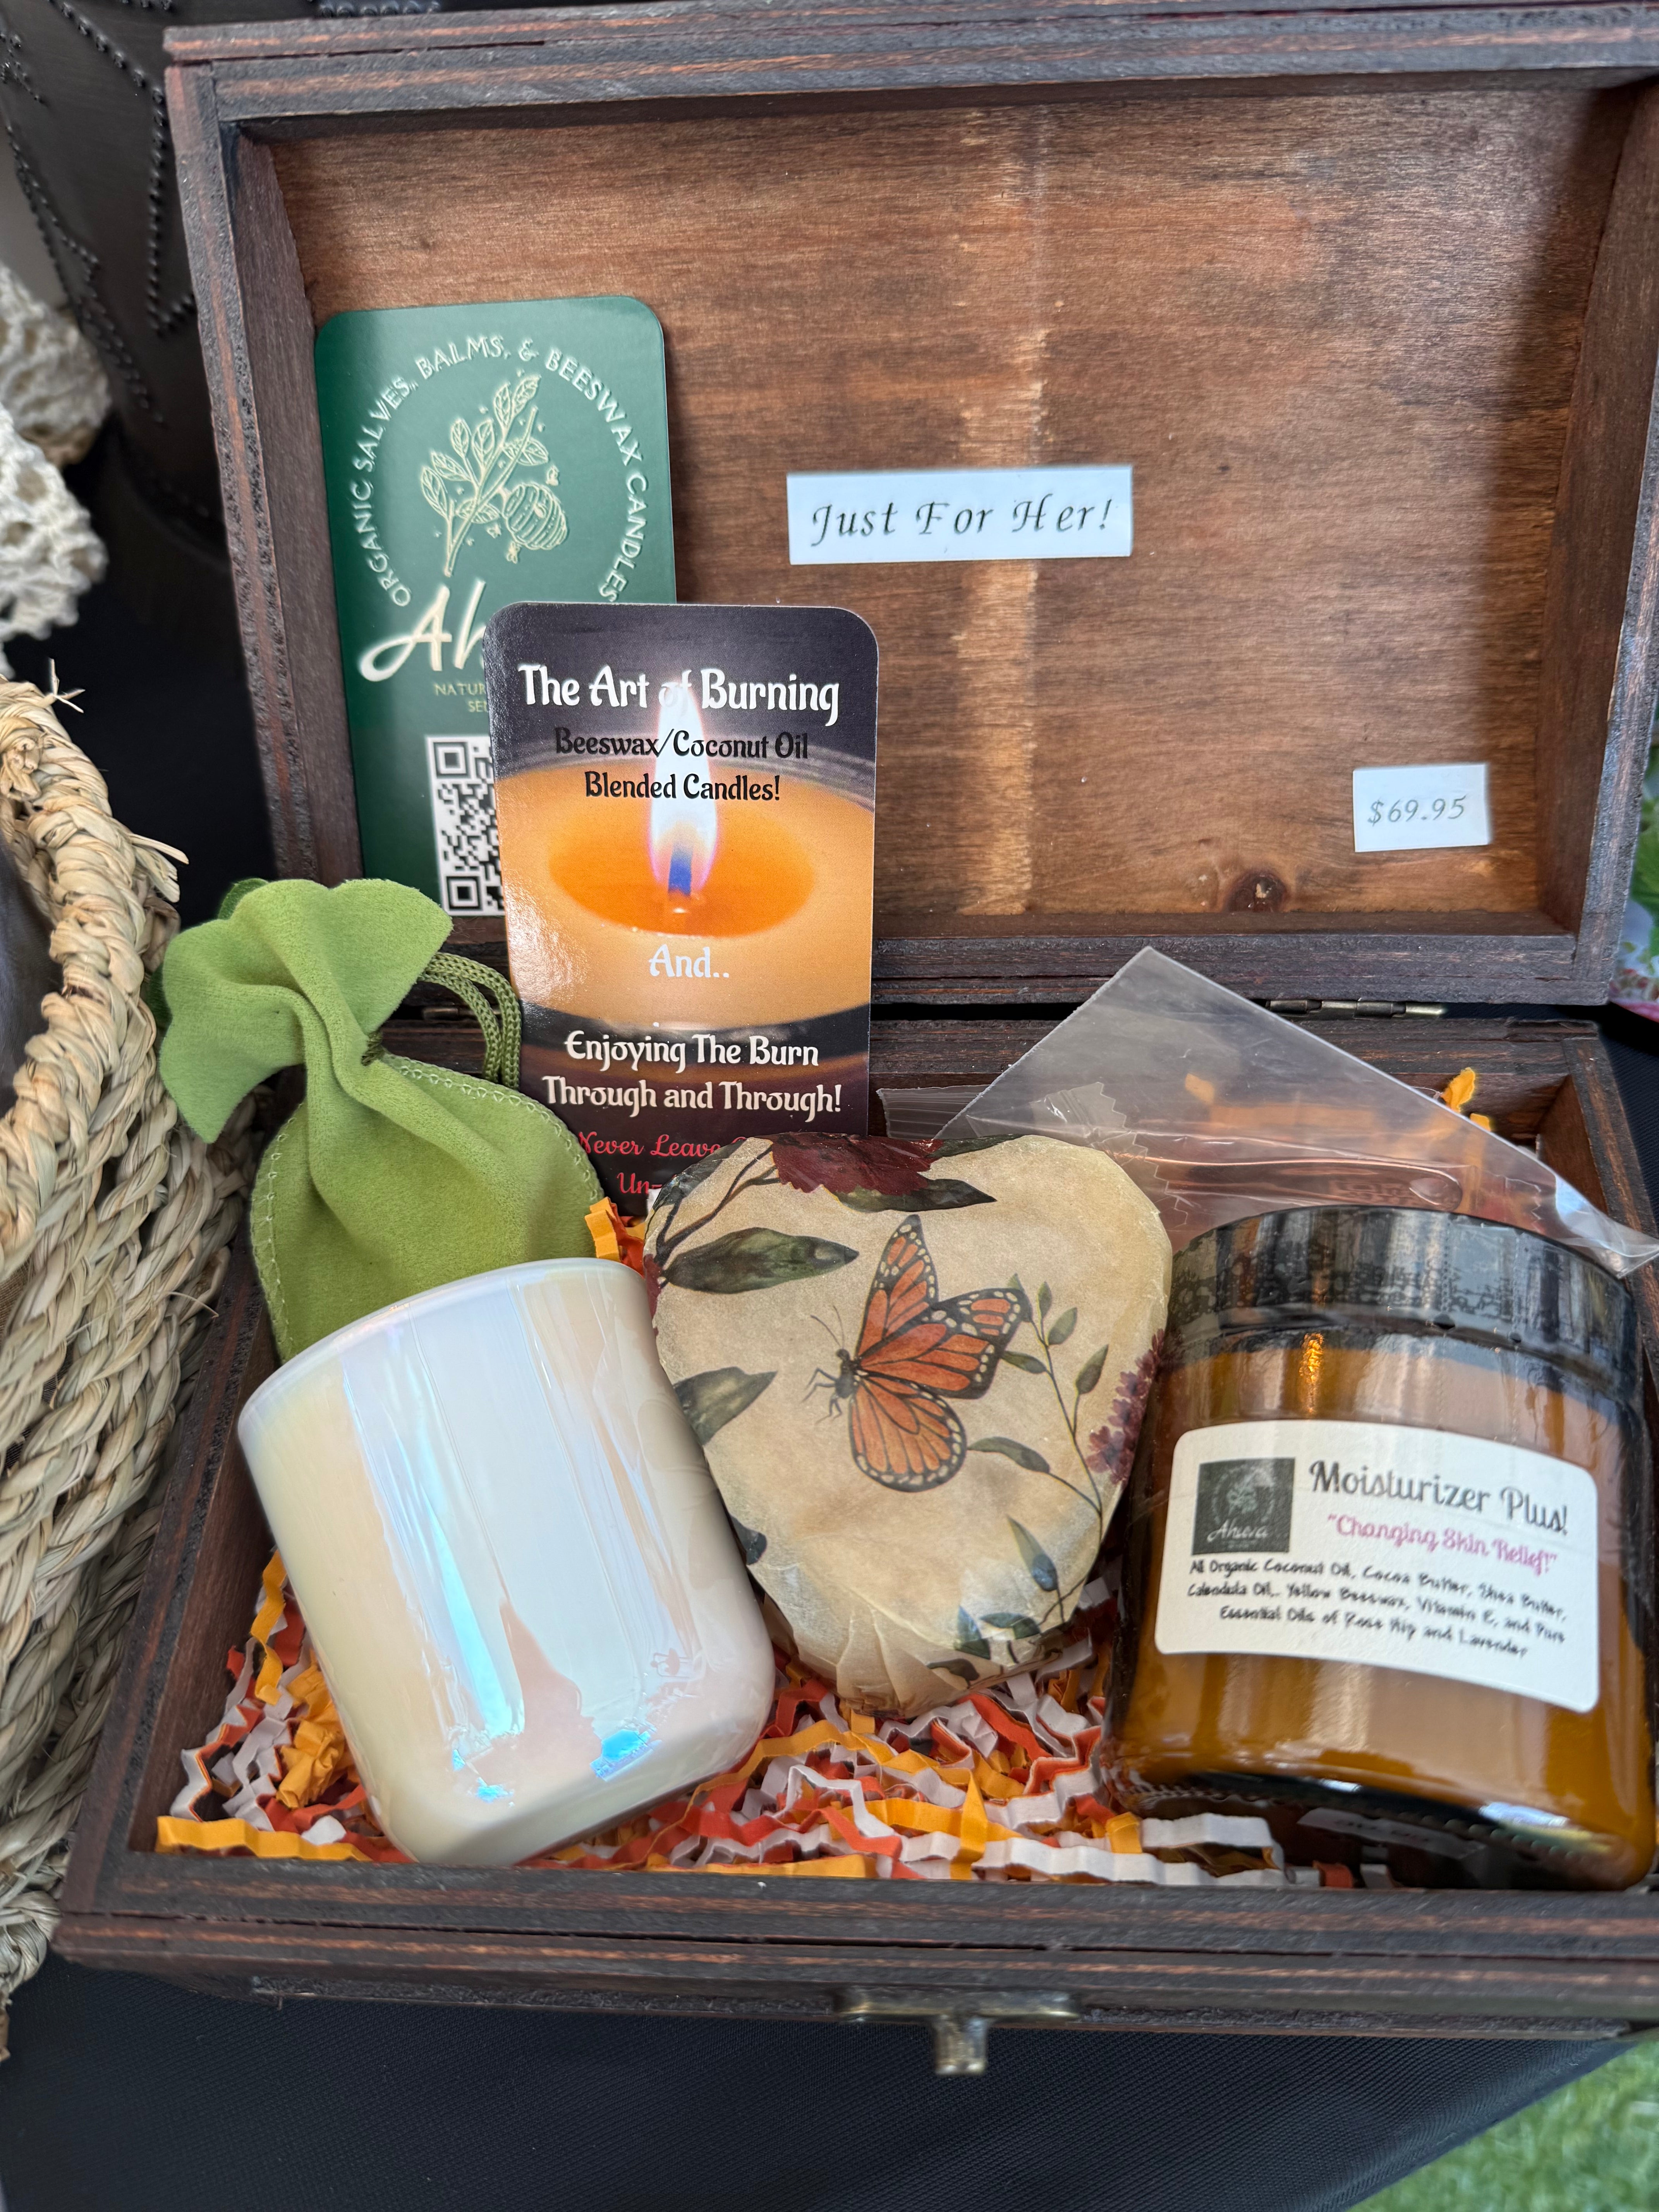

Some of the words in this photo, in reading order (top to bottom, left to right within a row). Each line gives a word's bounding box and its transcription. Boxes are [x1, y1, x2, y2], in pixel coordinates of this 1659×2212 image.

[351, 479, 412, 607] ORGANIC
[415, 334, 511, 380] BALMS,
[518, 337, 539, 361] &
[544, 348, 642, 467] BEESWAX
[598, 472, 648, 603] CANDLES
[811, 502, 898, 546] Just
[915, 501, 994, 535] For
[1012, 493, 1113, 533] Her!
[360, 580, 487, 682] Ah
[434, 682, 486, 696] NATUR
[518, 664, 580, 709] The
[589, 665, 649, 709] Art
[658, 670, 692, 709] of
[700, 668, 840, 726] Burning
[554, 726, 768, 759] Beeswax/Coconut
[775, 731, 808, 759] Oil
[585, 771, 676, 799] Blended
[684, 774, 780, 801] Candles!
[1367, 793, 1467, 827] $69.95
[649, 944, 730, 979] And..
[564, 1030, 687, 1073] Enjoying
[692, 1033, 741, 1064] The
[749, 1035, 819, 1066] Burn
[542, 1075, 657, 1117] Through
[664, 1081, 713, 1109] and
[719, 1081, 842, 1123] Through!
[579, 1131, 644, 1155] Never
[616, 1172, 662, 1194] Un-
[1309, 1460, 1490, 1511] Moisturizer
[1499, 1486, 1568, 1536] Plus!
[1442, 1527, 1489, 1557] Skin
[1209, 1559, 1258, 1578] Organic
[1264, 1558, 1324, 1575] Coconut
[1362, 1565, 1411, 1584] Cocoa
[1219, 1605, 1281, 1620] Essential
[1321, 1609, 1339, 1625] of
[1423, 1625, 1453, 1642] and
[1459, 1628, 1528, 1659] Lavender
[1416, 1596, 1476, 1621] Vitamin
[1504, 1618, 1530, 1633] and
